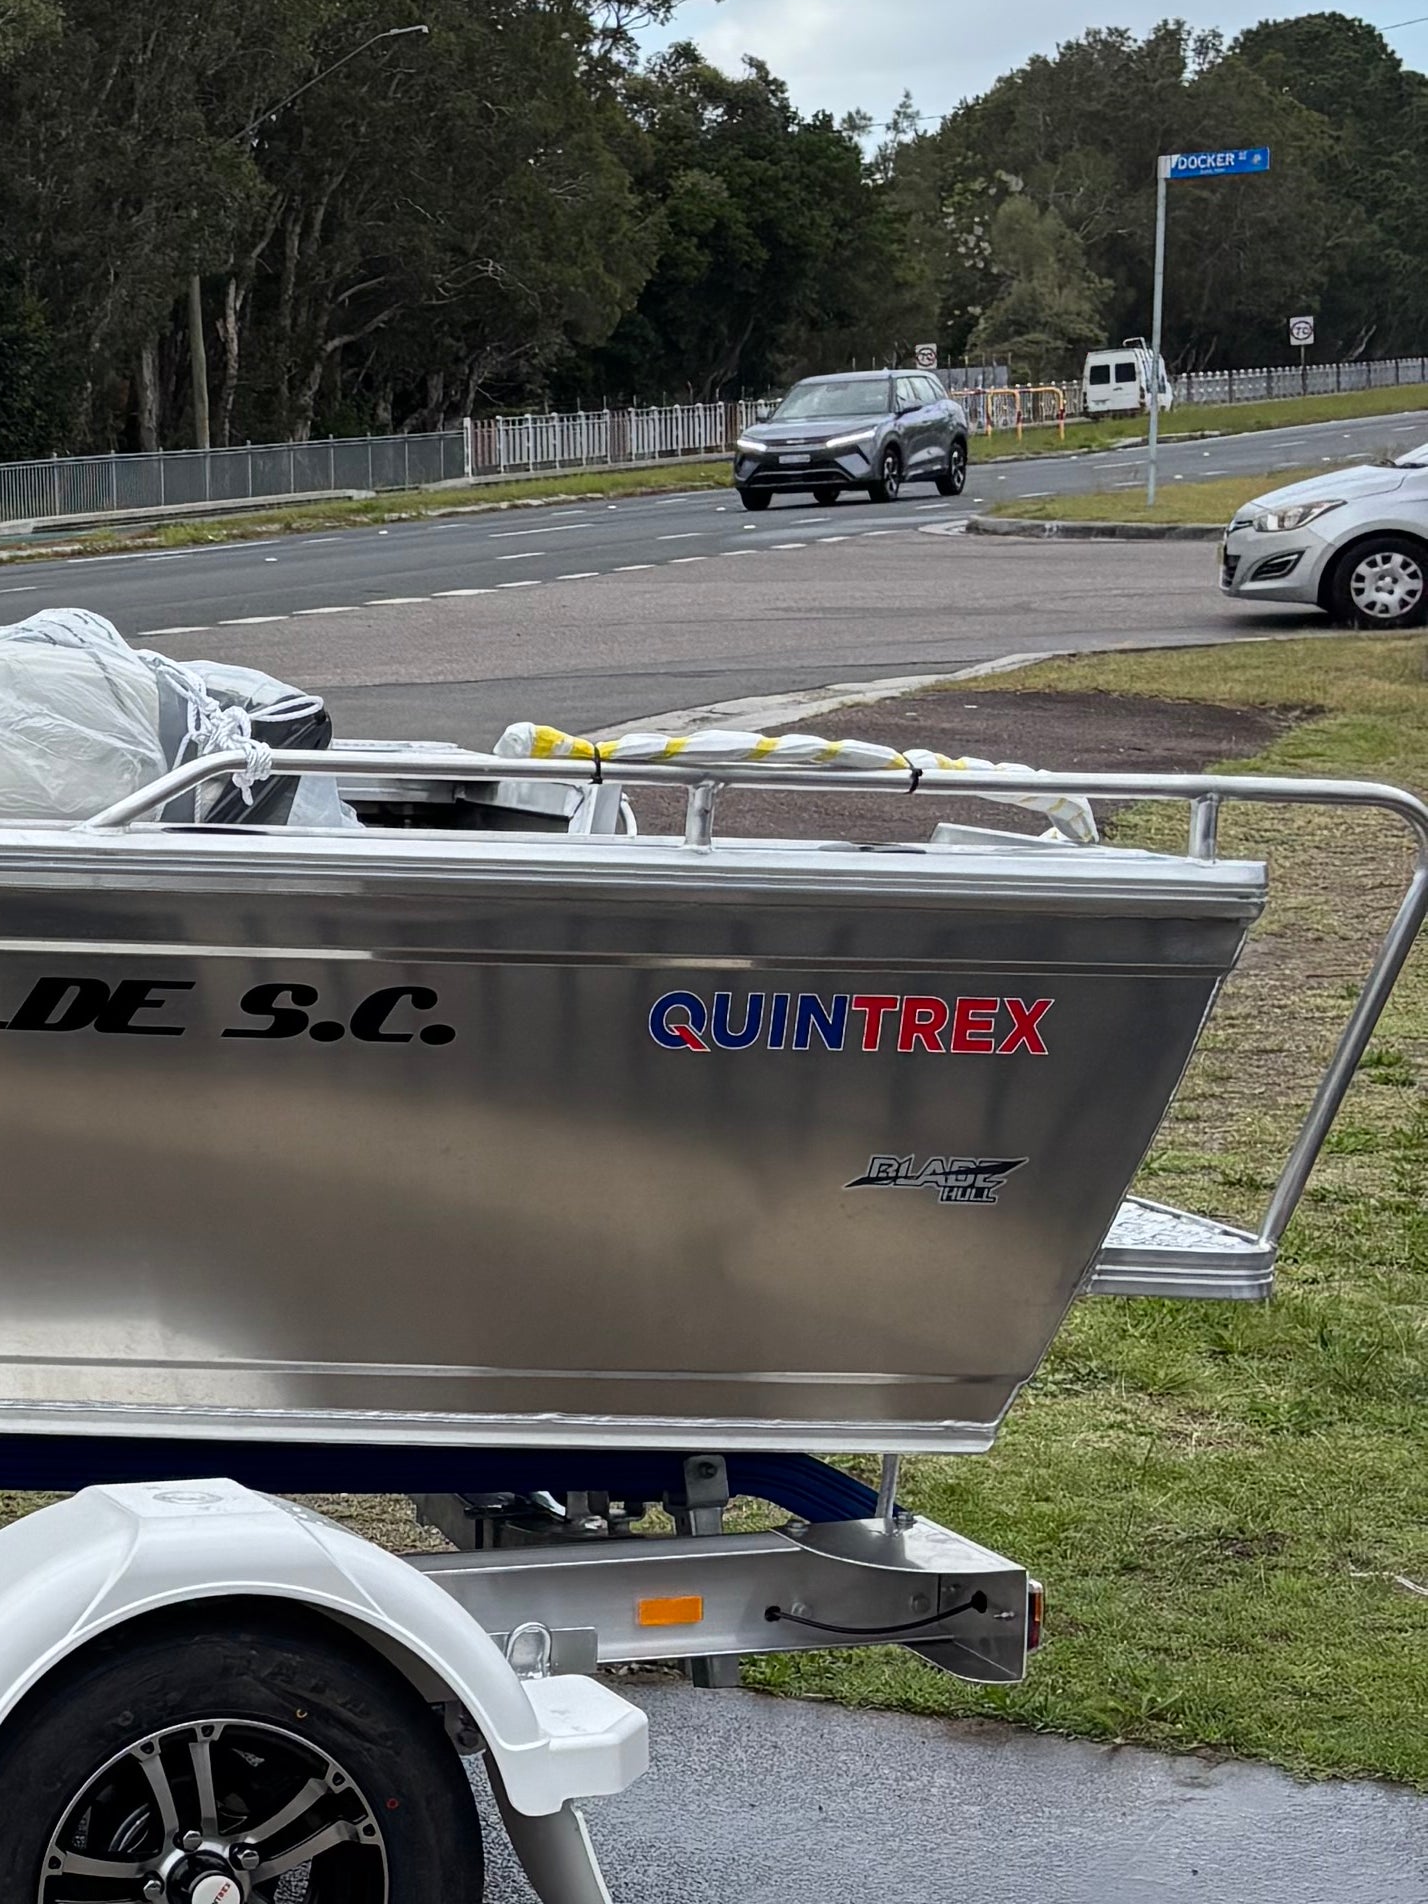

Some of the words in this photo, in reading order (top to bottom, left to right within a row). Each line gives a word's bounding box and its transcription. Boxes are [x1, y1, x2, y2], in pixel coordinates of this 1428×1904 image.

[1177, 153, 1235, 170] DOCKER
[221, 982, 456, 1045] S.C.
[649, 990, 1055, 1055] QUINTREX
[856, 1154, 1029, 1189] BLADE
[942, 1186, 996, 1202] HULL
